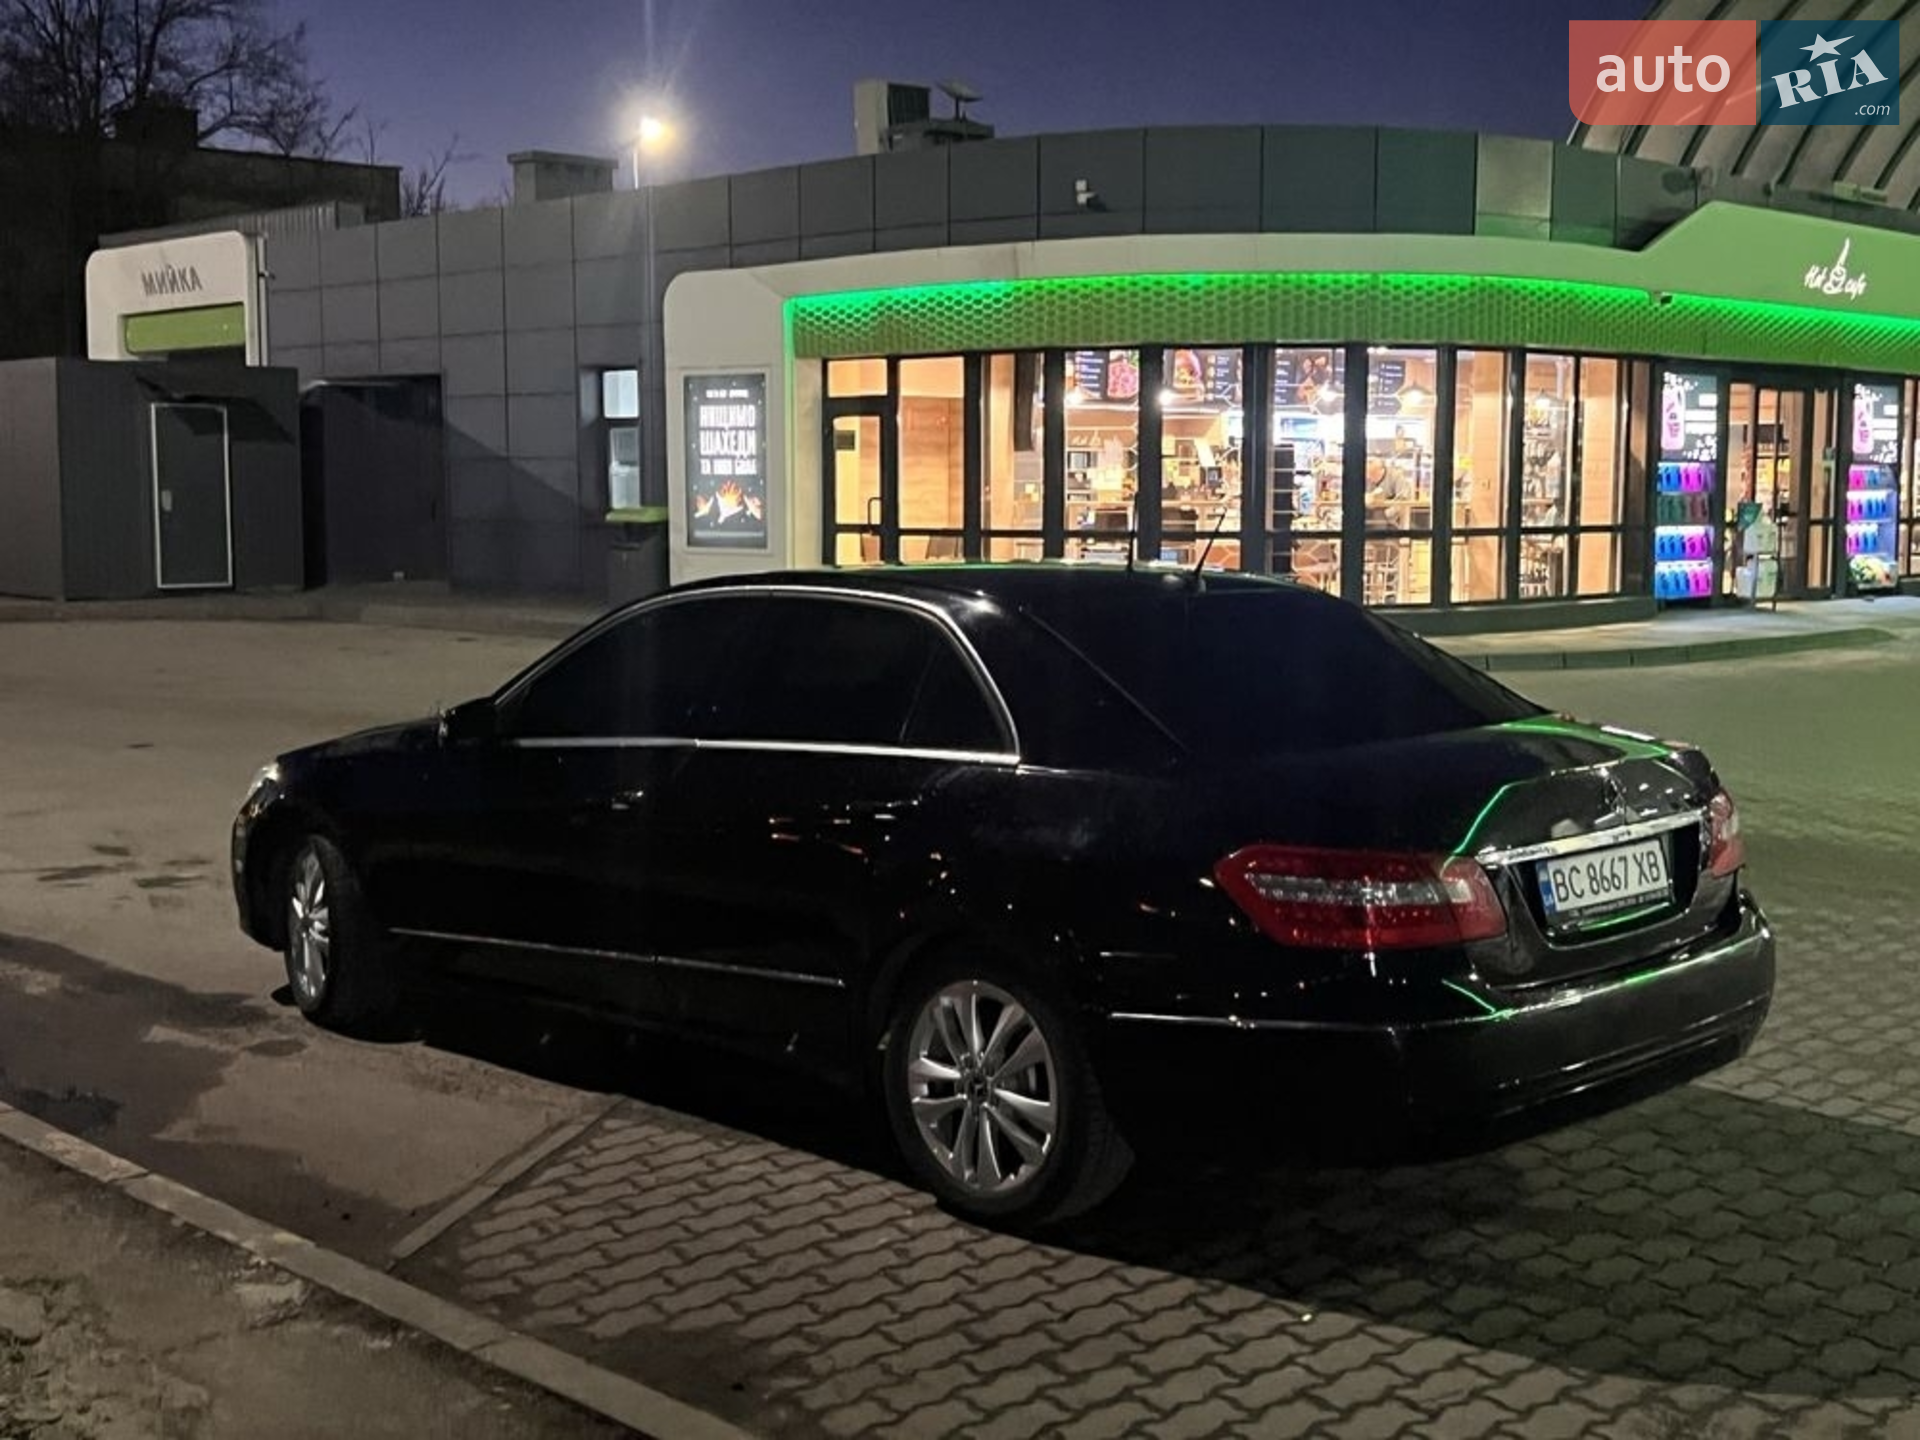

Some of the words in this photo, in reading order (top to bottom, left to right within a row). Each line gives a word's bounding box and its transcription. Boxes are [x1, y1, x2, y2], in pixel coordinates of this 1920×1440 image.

[140, 263, 203, 297] МИЙКА
[1553, 865, 1585, 902] BC
[1587, 857, 1629, 895] 8667
[1633, 850, 1661, 886] XB
